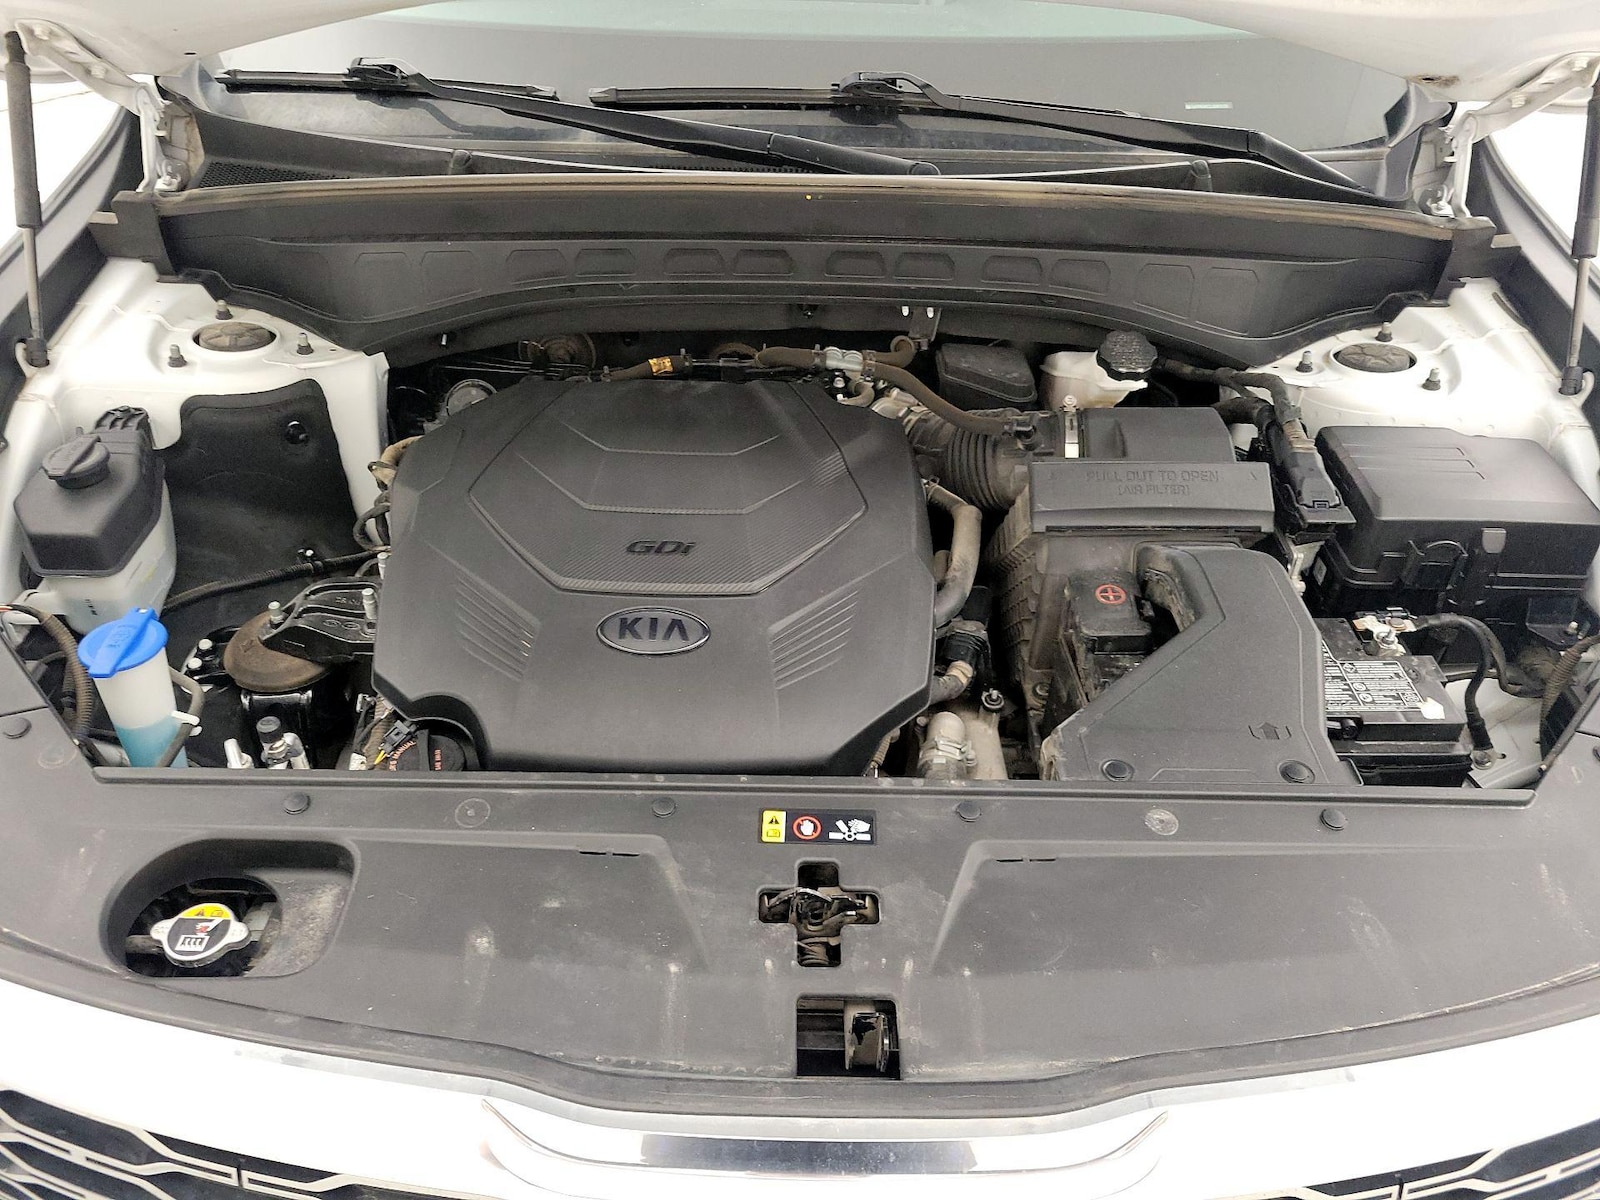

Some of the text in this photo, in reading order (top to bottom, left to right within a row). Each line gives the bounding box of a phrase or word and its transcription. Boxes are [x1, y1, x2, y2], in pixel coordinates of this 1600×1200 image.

[1086, 470, 1219, 483] PULL OUT TO OPEN
[618, 617, 690, 641] KIA
